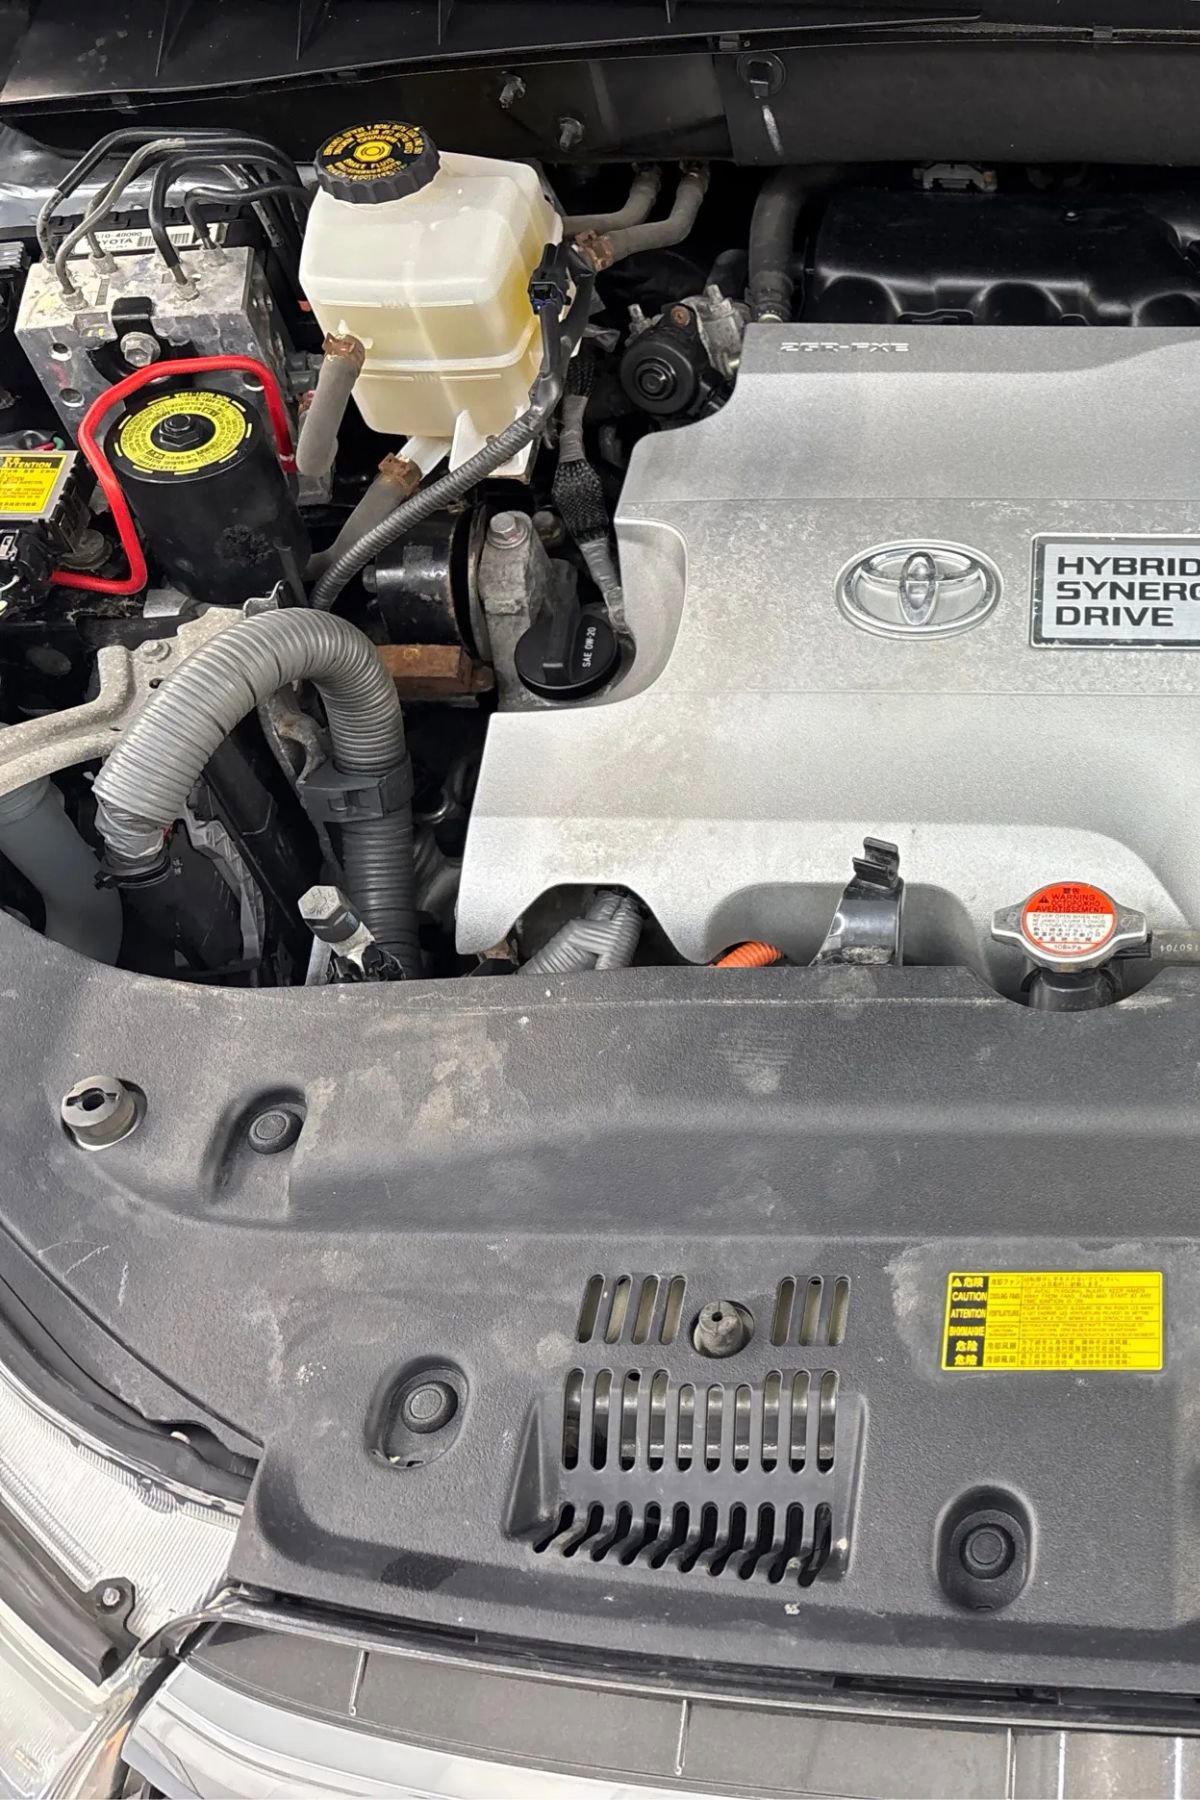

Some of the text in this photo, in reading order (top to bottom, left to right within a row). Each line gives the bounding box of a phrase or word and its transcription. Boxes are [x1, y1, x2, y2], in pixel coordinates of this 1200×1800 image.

[1055, 606, 1174, 627] DRIVE
[582, 626, 597, 667] SAE 0W-20
[952, 1291, 987, 1301] CAUTION
[950, 1308, 986, 1318] ATTENTION
